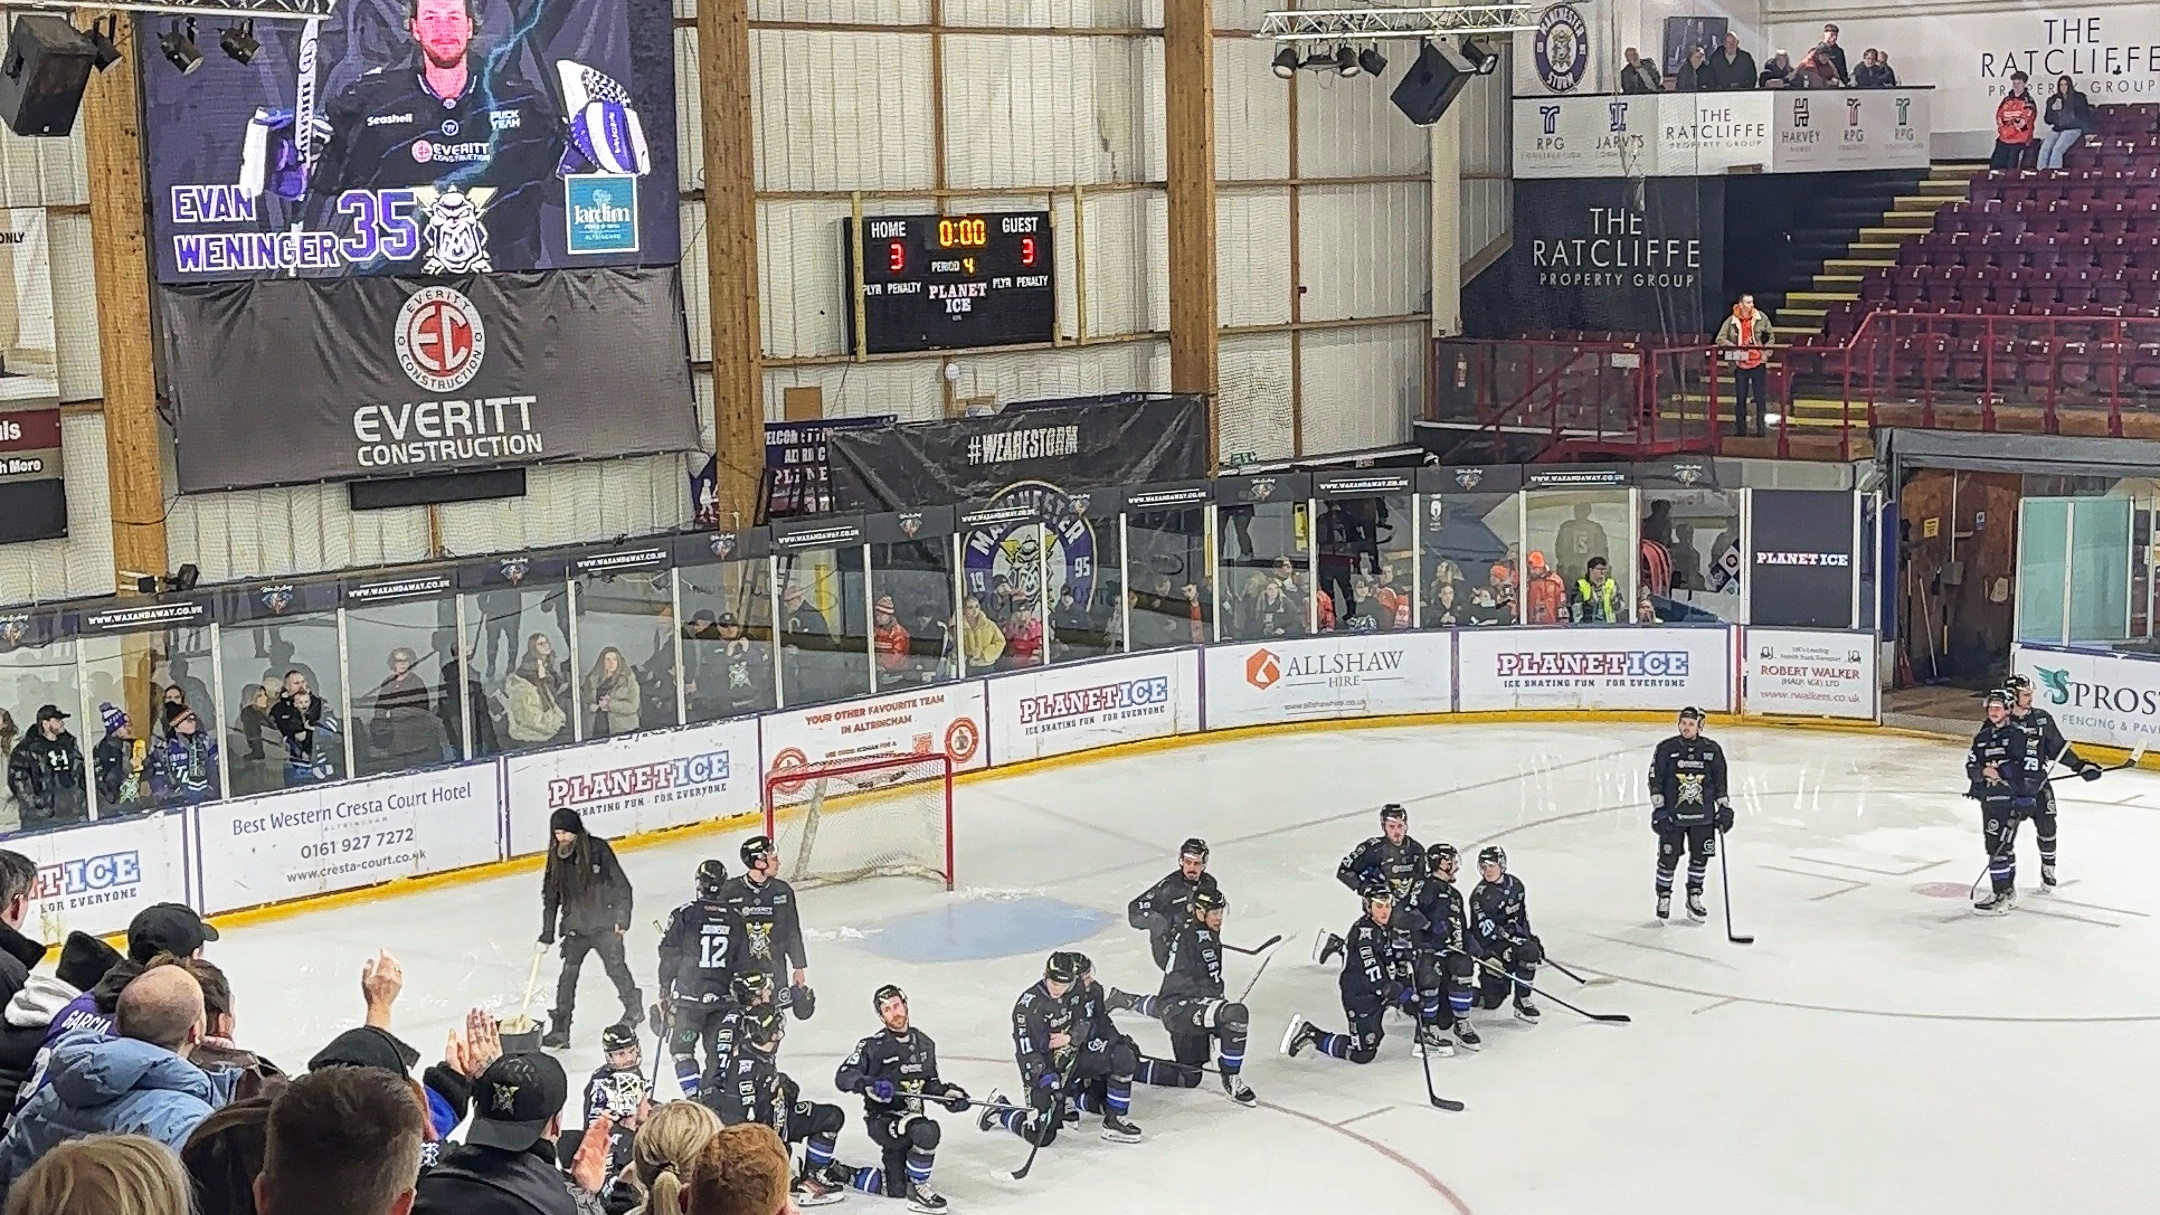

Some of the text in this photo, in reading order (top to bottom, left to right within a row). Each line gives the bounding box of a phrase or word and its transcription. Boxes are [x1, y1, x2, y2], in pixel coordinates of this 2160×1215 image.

[2044, 18, 2100, 45] THE
[1982, 46, 2160, 77] RATCLIFFE
[1989, 80, 2155, 96] PRPER GROUP
[366, 113, 412, 126] Seashell
[1700, 108, 1731, 122] THE
[1666, 124, 1765, 140] RATCLIFFE
[1782, 130, 1821, 144] HARVEY
[1843, 129, 1864, 143] RPG
[1895, 128, 1914, 141] RPG
[433, 142, 490, 155] EVERITT
[1537, 137, 1565, 150] RPG
[1726, 140, 1762, 148] GROUP
[171, 184, 256, 223] EVAN
[574, 203, 630, 225] Jardim
[336, 189, 419, 261] 35
[871, 221, 906, 238] HOME
[1002, 217, 1038, 233] GUEST
[1589, 208, 1642, 235] THE
[939, 219, 986, 247] 0:00
[174, 231, 341, 272] WENINGER
[890, 243, 904, 270] 3
[1022, 238, 1034, 264] 3
[1533, 239, 1700, 268] RATCLIFFE
[931, 258, 975, 274] PERIOD 4
[887, 282, 921, 294] PENALTY
[929, 283, 987, 299] PLANET
[1017, 275, 1049, 287] PENALTY
[1540, 273, 1694, 288] PROPERTY GROUP
[407, 289, 470, 313] EVERITT
[946, 299, 971, 313] ICE
[401, 350, 482, 389] CONSTRUCTION
[353, 396, 537, 442] EVERITT
[358, 433, 543, 466] CONSTRUCTION
[967, 426, 1079, 465] #WEARESTORM
[1074, 556, 1091, 578] 95
[1756, 552, 1848, 566] PLANET ICE
[349, 579, 450, 598] WWW.WAXANDAWAY.CO.UK
[970, 571, 986, 593] 19
[88, 604, 203, 626] WWW.WAXANDAWAY.CO.UK
[1285, 650, 1405, 677] ALLSHAW
[1760, 665, 1860, 679] ROBERT WALKER
[1329, 676, 1360, 688] HIRE
[1504, 679, 1685, 688] ICE SKATING FUN FOR EVERYONE
[2051, 668, 2160, 715] SPROS
[805, 694, 945, 726] YOUR OTHER FAVOURITE TEAM
[1025, 705, 1165, 736] ICE SKATING FUN FOR EVERYONE
[841, 715, 912, 735] IN ALTRINCHAM
[2062, 715, 2115, 730] FENCING
[2121, 722, 2128, 732] &
[2024, 757, 2039, 771] 79
[625, 797, 644, 809] FUN
[655, 792, 673, 803] FOR
[677, 783, 727, 800] EVERYONE
[232, 782, 471, 836] Best Western Cresta Court Hotel
[301, 827, 414, 860] 0161 927 7272
[65, 850, 141, 895] ICE
[287, 849, 427, 883] www.cresta-court.co.uk
[70, 888, 137, 908] EVERYONE
[1479, 919, 1495, 937] 20
[699, 936, 728, 967] 12
[62, 1010, 112, 1035] GARCIA
